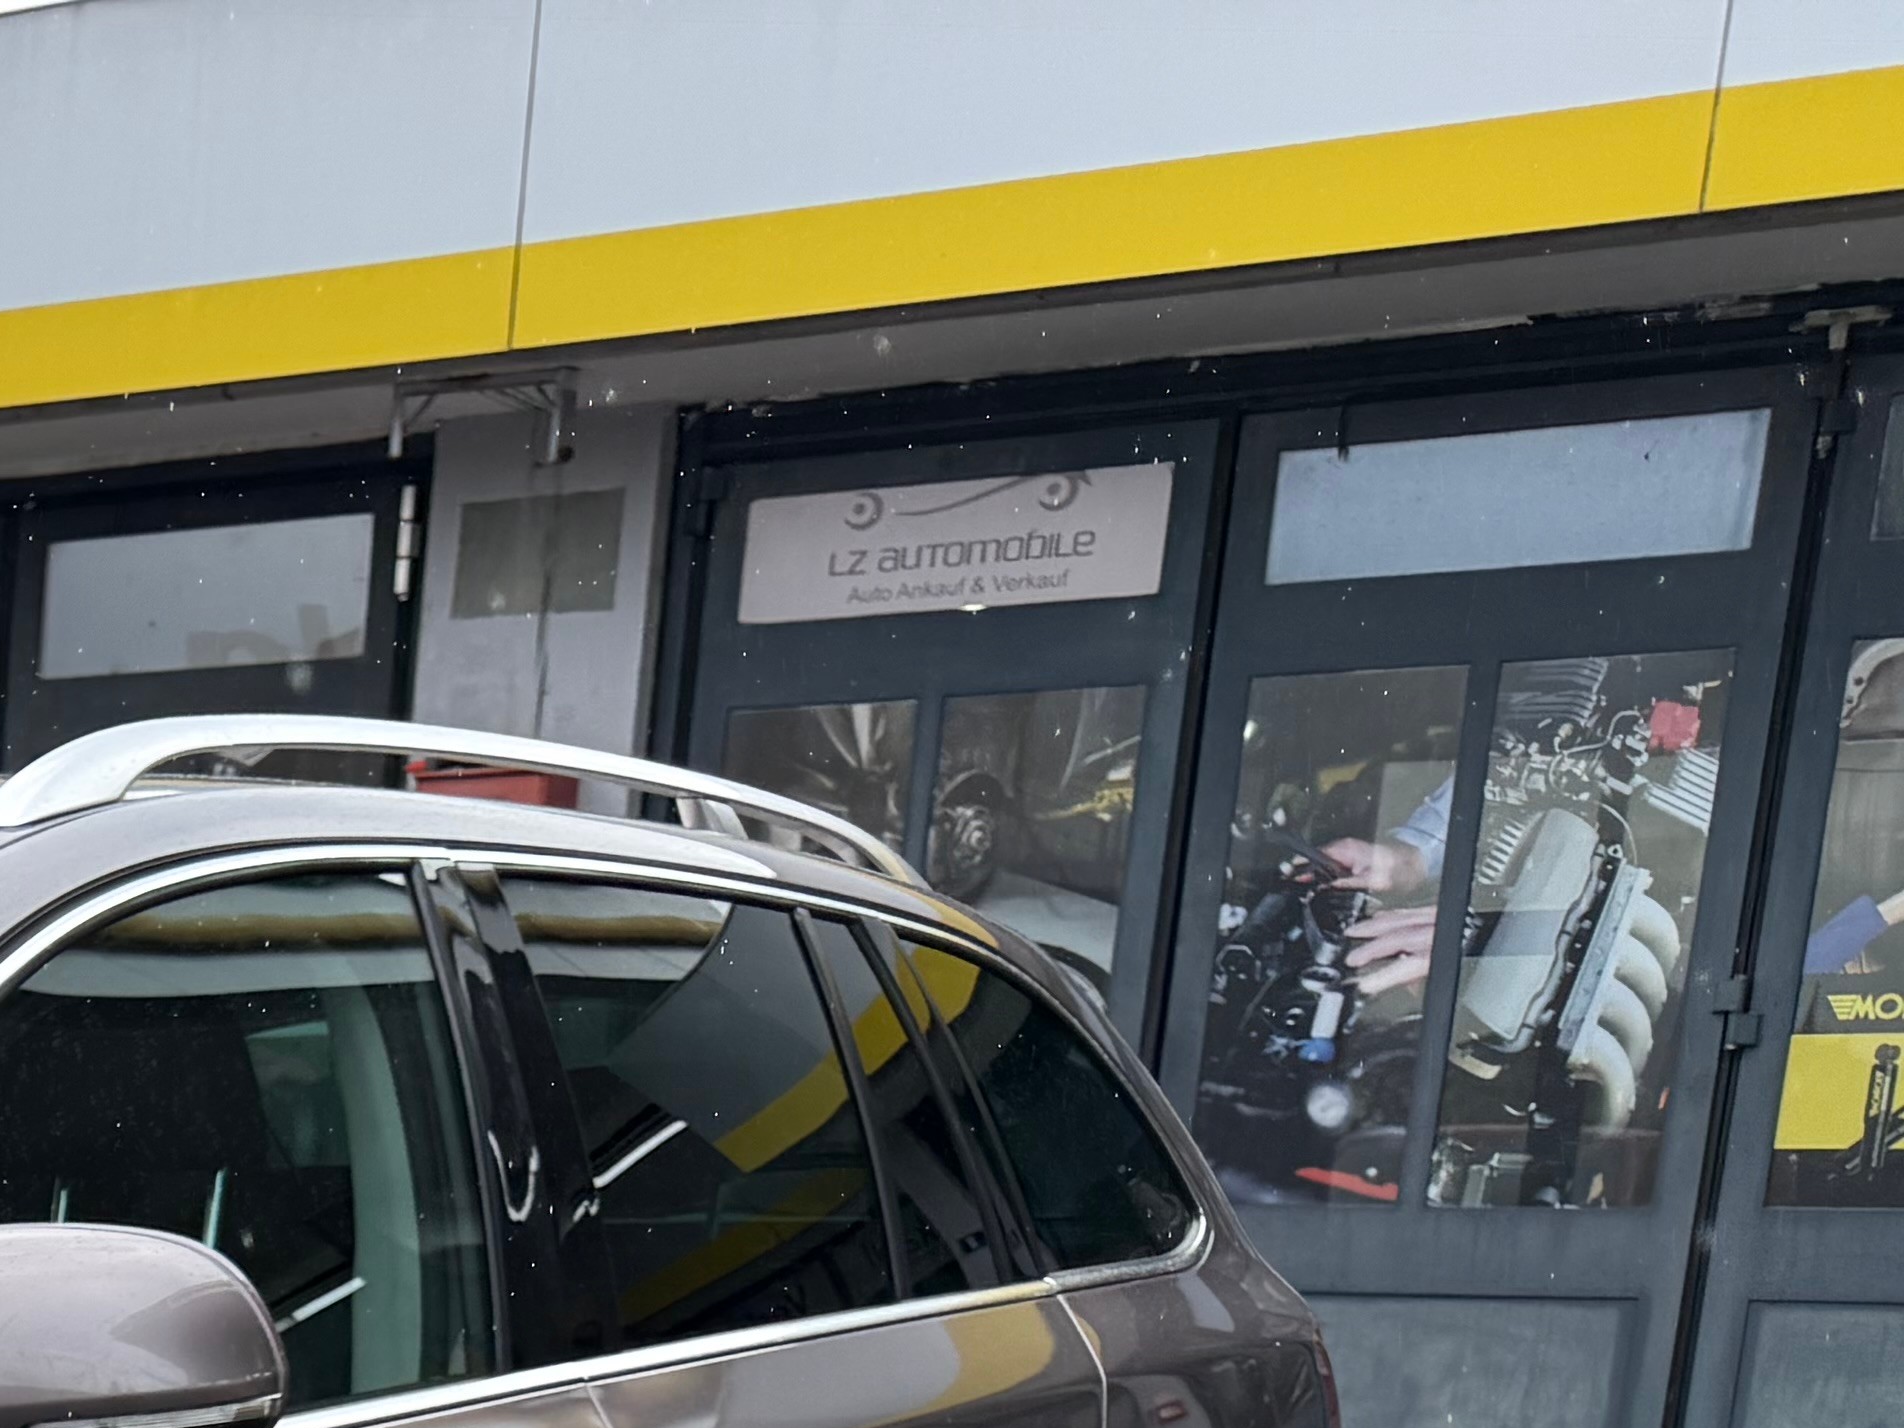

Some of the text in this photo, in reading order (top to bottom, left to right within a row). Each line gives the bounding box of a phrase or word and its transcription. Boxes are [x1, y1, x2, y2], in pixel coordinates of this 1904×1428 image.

[828, 549, 869, 577] LZ
[847, 568, 1072, 605] Auto Ankauf & Verkauf
[1849, 992, 1904, 1021] MO
